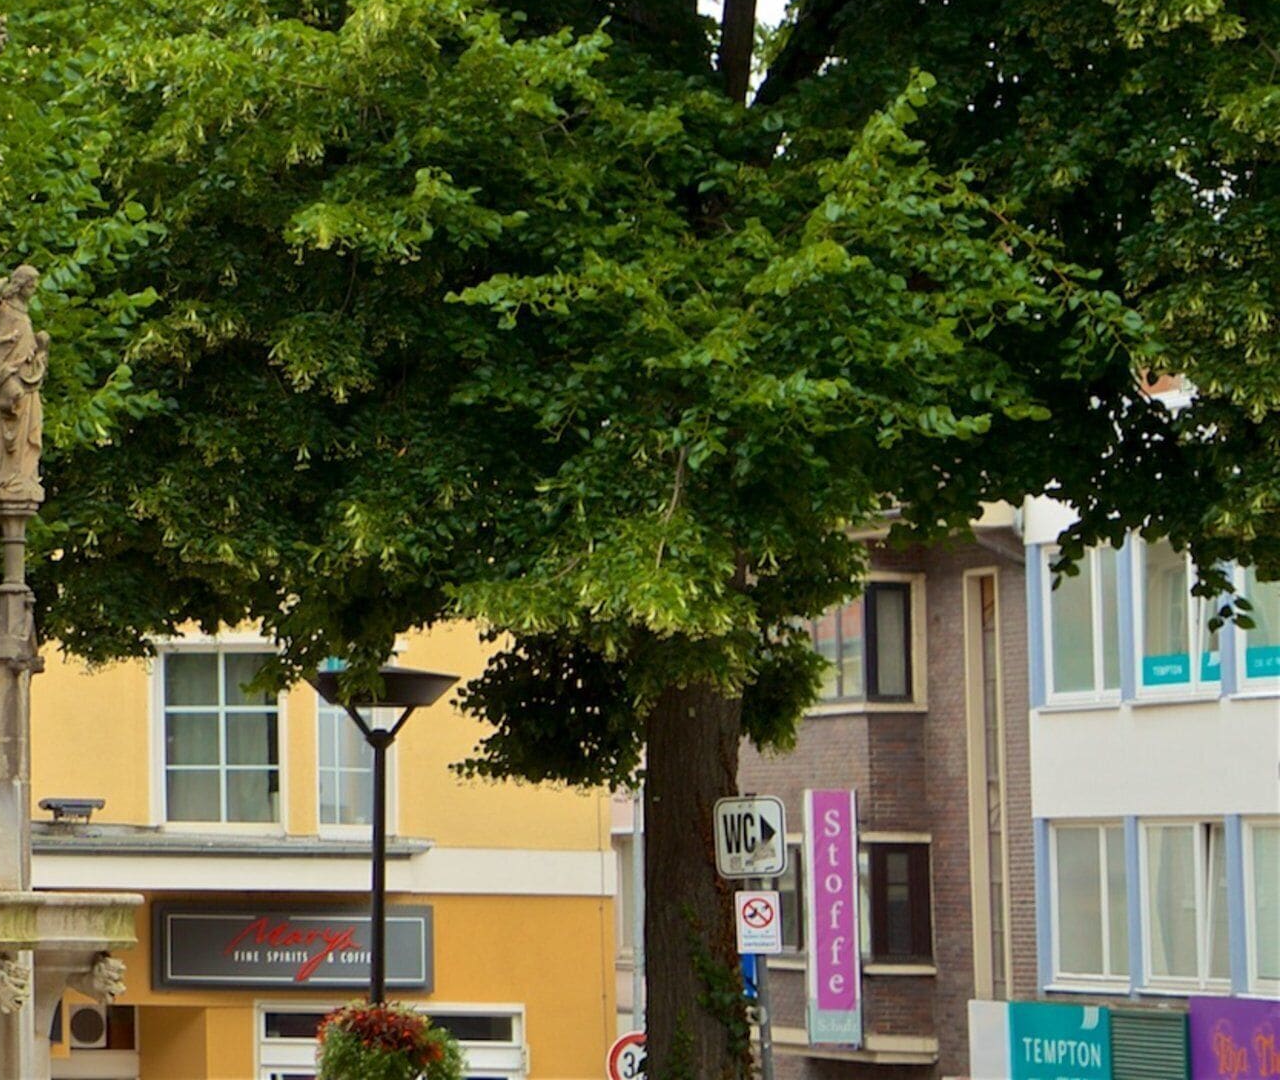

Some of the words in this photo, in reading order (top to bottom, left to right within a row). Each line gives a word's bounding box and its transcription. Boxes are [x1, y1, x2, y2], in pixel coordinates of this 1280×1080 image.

[723, 812, 756, 854] WC
[823, 809, 845, 994] Stoffe
[234, 951, 259, 962] FINE
[267, 951, 308, 962] SPIRITS
[1022, 1037, 1102, 1067] TEMPTON
